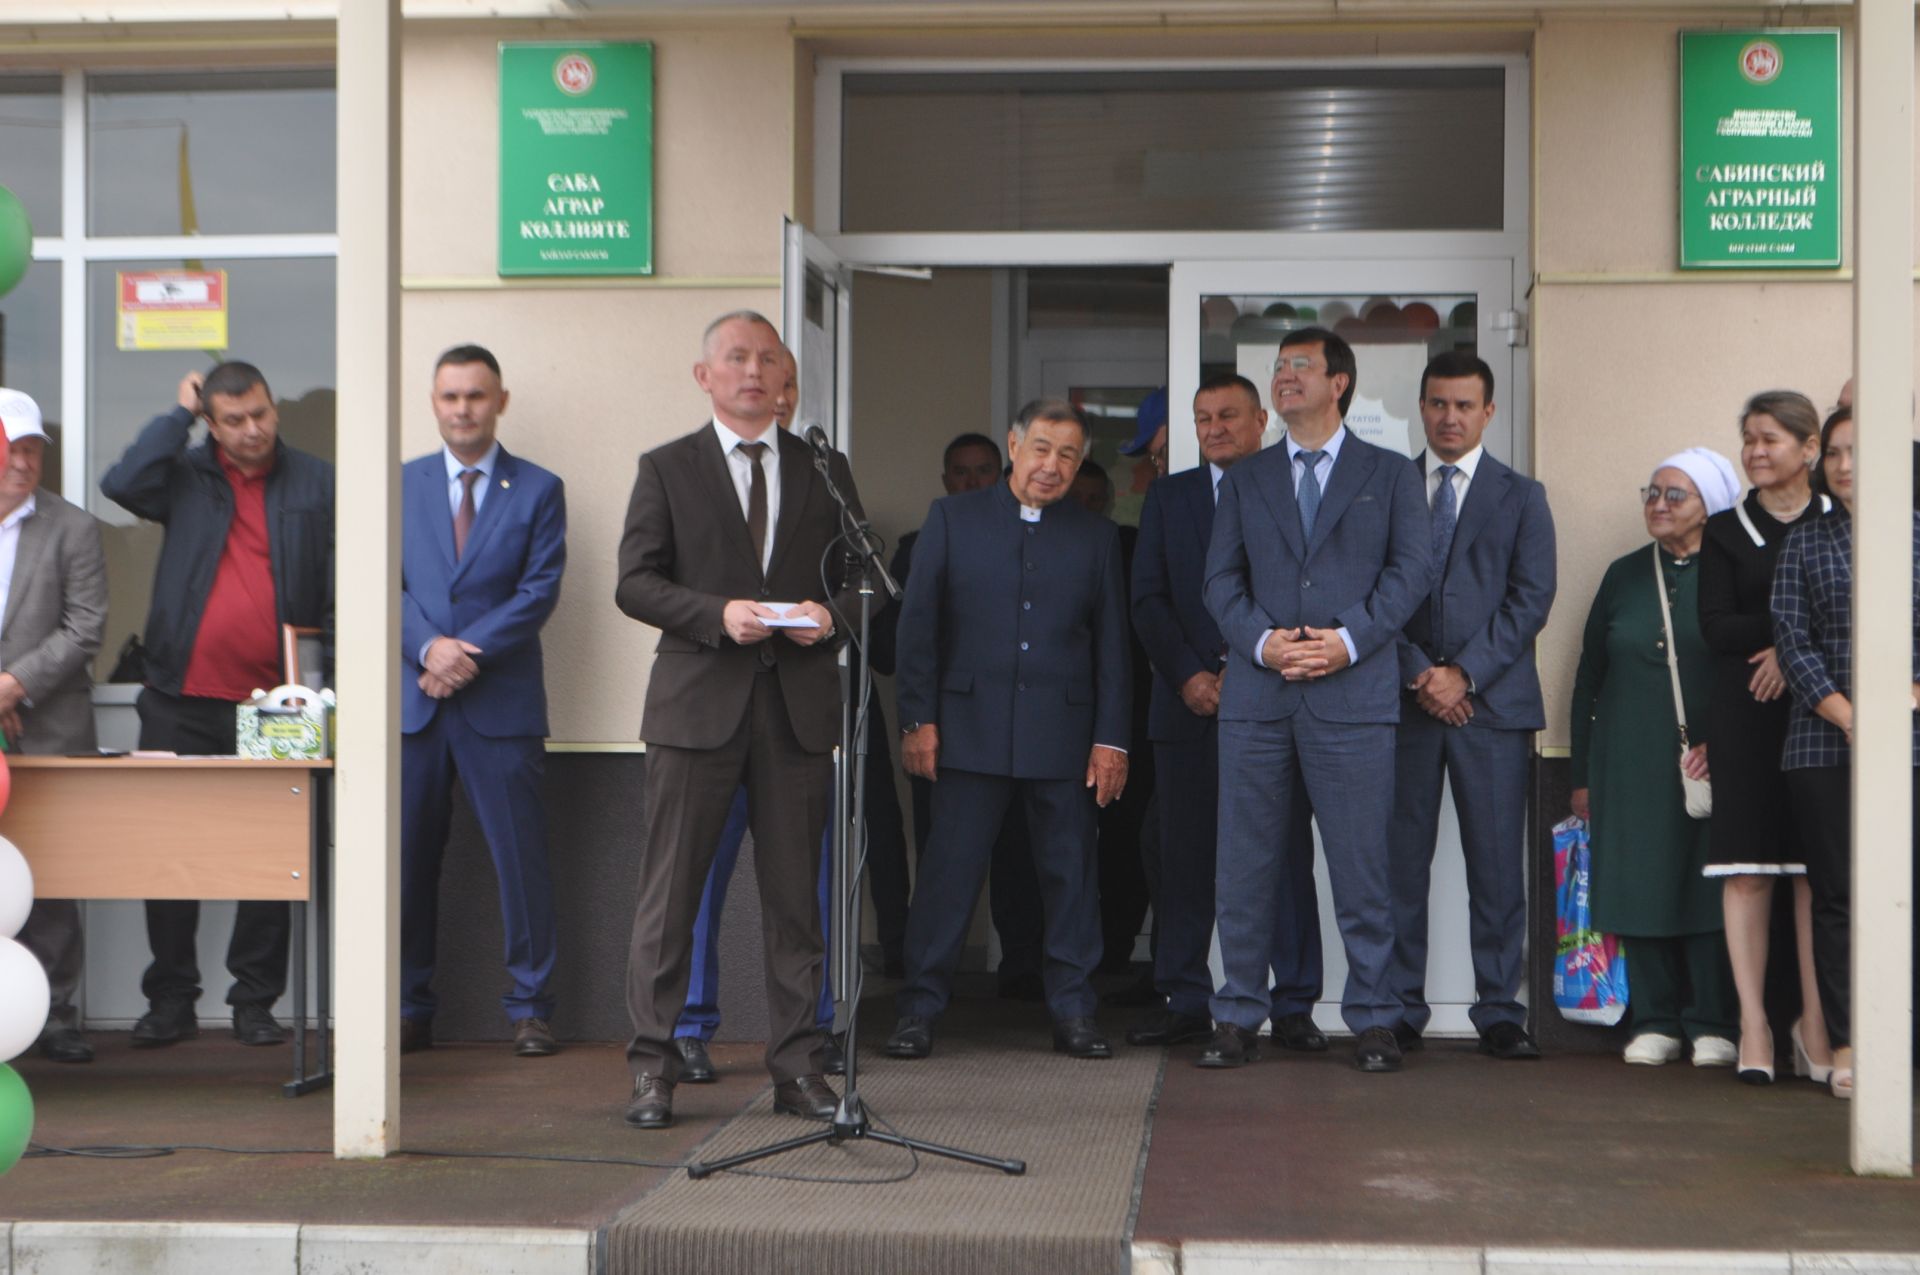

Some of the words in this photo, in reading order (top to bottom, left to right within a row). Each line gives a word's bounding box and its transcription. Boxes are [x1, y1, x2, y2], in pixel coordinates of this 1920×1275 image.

[1695, 159, 1825, 182] САБИНСКИЙ
[547, 173, 601, 192] САБА
[1704, 184, 1817, 207] АГРАРНЫЙ
[543, 197, 605, 216] АГРАР
[1710, 211, 1814, 232] КОЛЛЕДЖ
